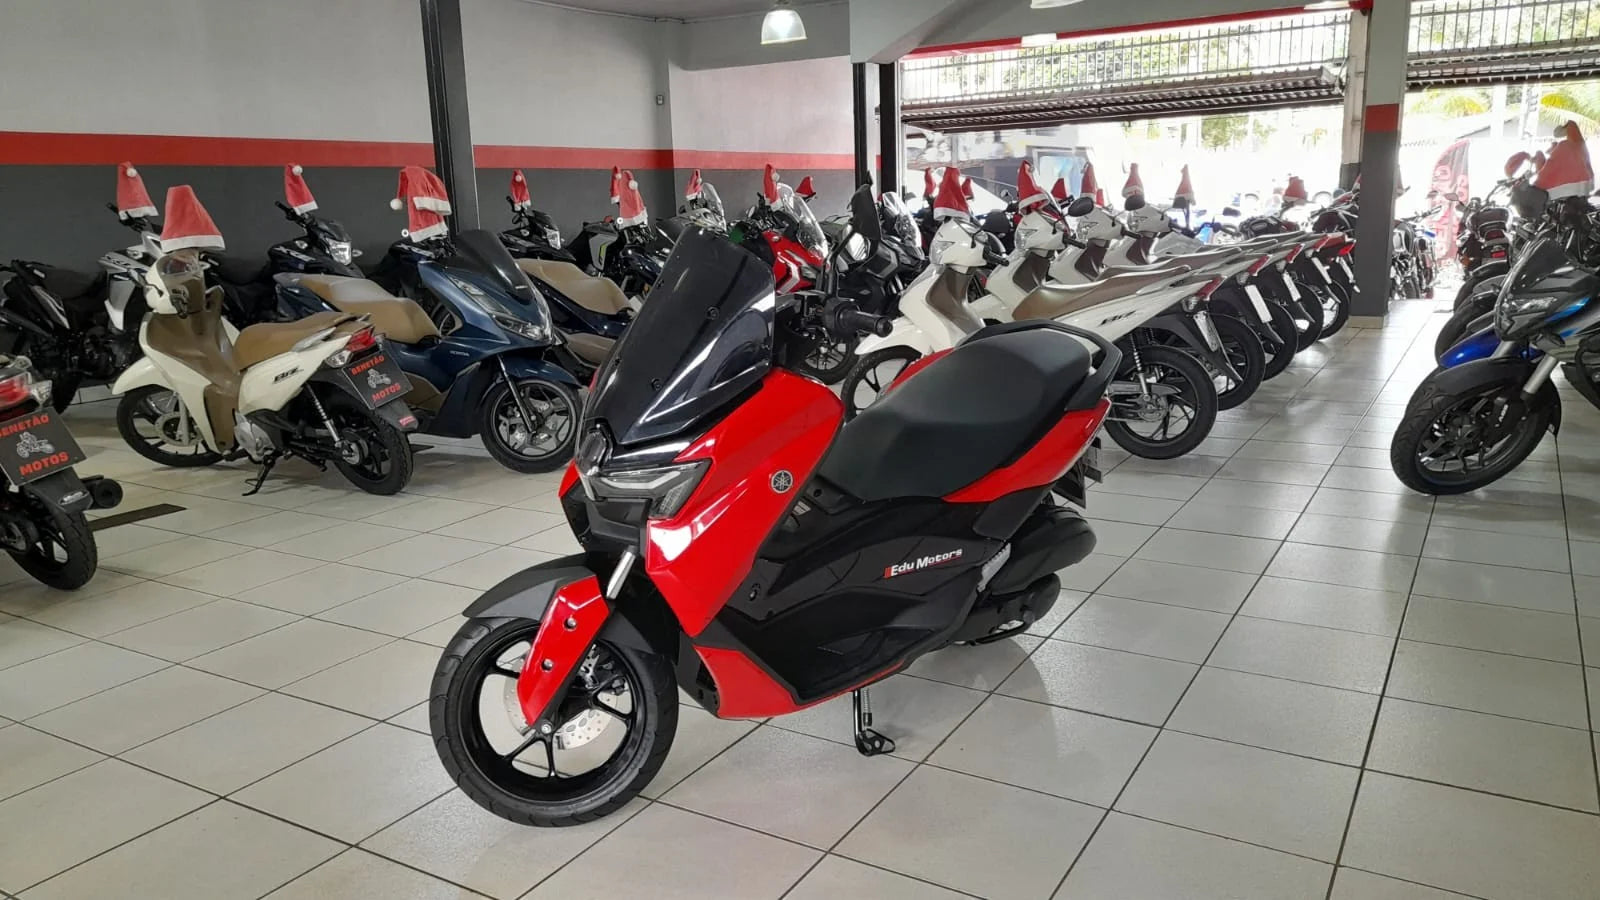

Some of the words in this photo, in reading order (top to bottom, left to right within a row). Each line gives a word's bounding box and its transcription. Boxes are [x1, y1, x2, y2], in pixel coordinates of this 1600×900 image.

[372, 382, 401, 401] MOTOS
[0, 413, 49, 438] ENETÃO
[19, 451, 69, 476] MOTOS
[890, 562, 915, 577] Edu
[916, 548, 963, 570] Motors
